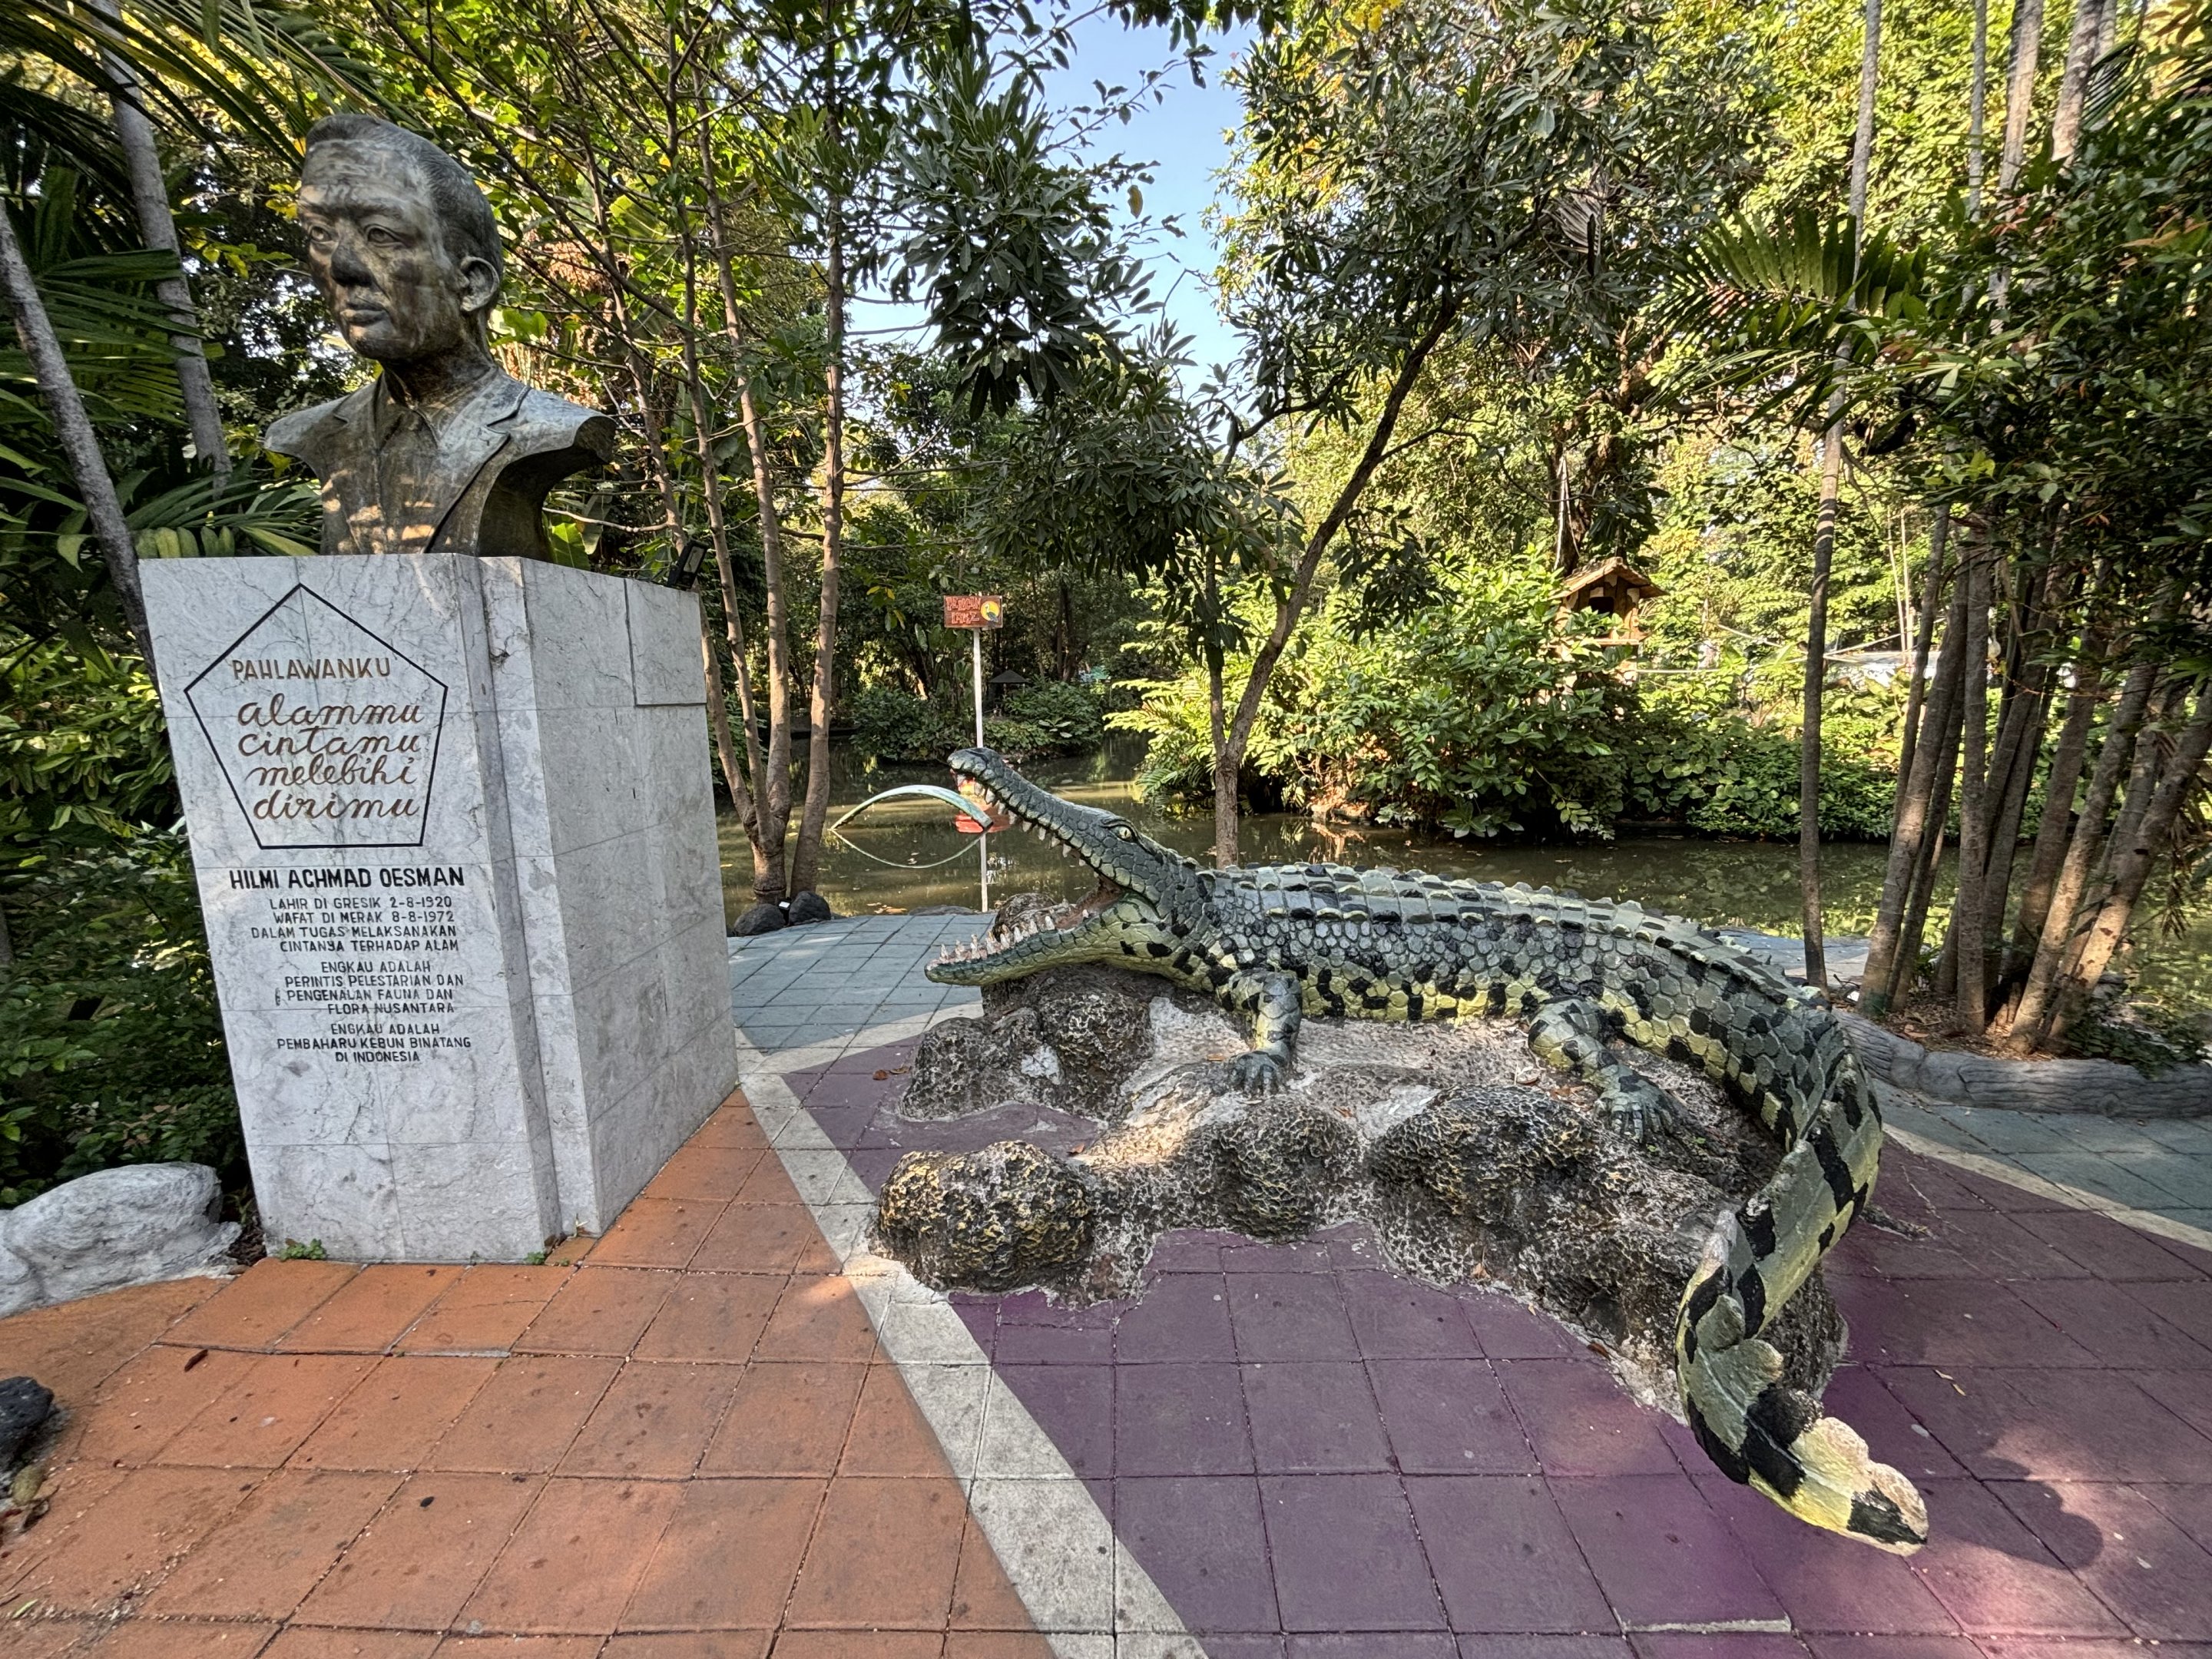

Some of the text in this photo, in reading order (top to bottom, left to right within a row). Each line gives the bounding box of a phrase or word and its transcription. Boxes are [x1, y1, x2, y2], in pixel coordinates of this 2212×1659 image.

[232, 658, 390, 680] PAHLAWANKU
[237, 693, 423, 726] alammu
[238, 727, 421, 756] cintamu
[245, 753, 416, 786] melebihi
[253, 790, 420, 820] dirimu
[230, 867, 465, 889] HILMI ACHMAD OESMAN
[270, 896, 452, 909] LAHIR DI GRESIK 2-8-1920
[273, 911, 454, 923] WAFAT DI MERAK 8-8-1972
[252, 926, 456, 938] DALAM TUGAS MELAKSANAKAN
[280, 940, 459, 952] CINTANYA TERHADAP ALAM
[322, 962, 430, 973] ENGKAU ADALAH
[285, 974, 463, 988] PERINTIS PELESTARIAN DAN
[287, 989, 452, 1002] PENGENALAN FAUNA DAN
[328, 1003, 454, 1015] FLORA NUSANTARA
[332, 1024, 439, 1035] ENGKAU ADALAH
[277, 1036, 471, 1049] PEMBAHARU KEBUN BINATANG
[336, 1051, 419, 1062] DI INDONESIA
